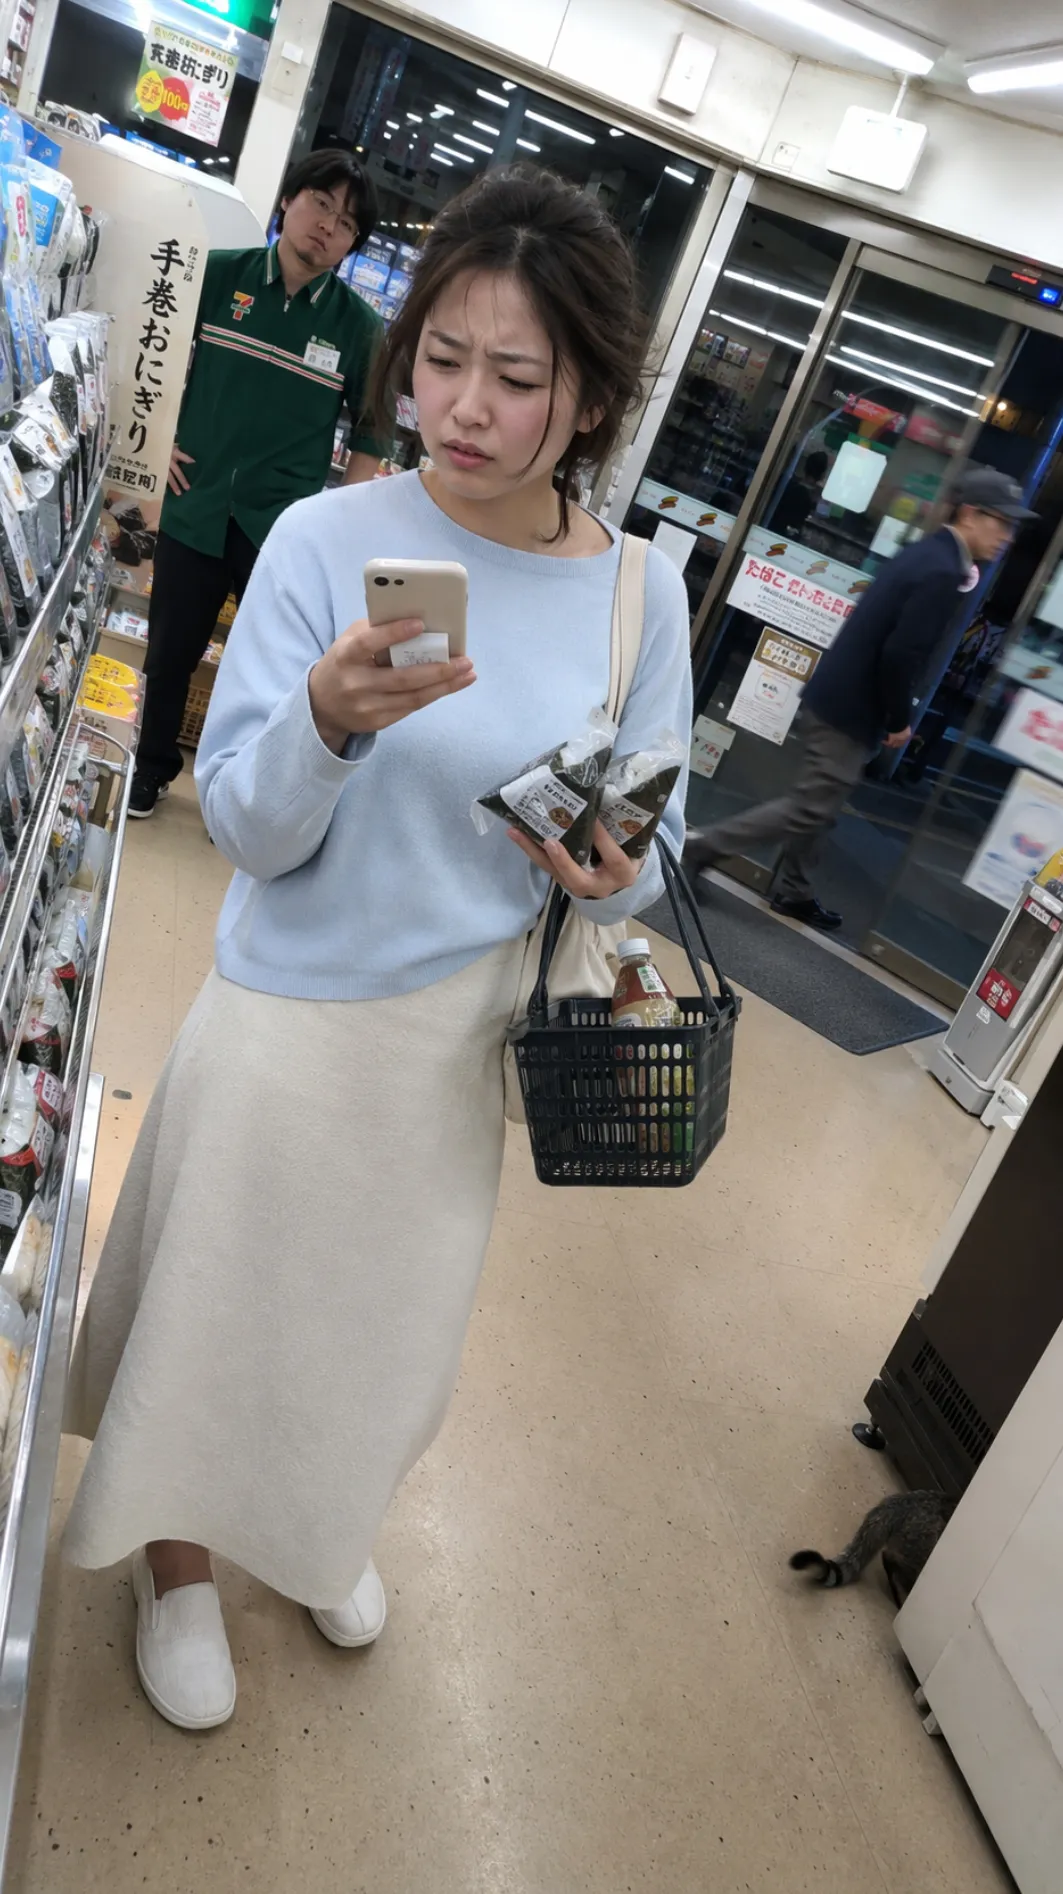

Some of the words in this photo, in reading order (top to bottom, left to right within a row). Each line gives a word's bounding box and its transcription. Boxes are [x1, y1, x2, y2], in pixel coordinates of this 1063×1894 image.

[128, 238, 185, 454] 手巻おにぎり
